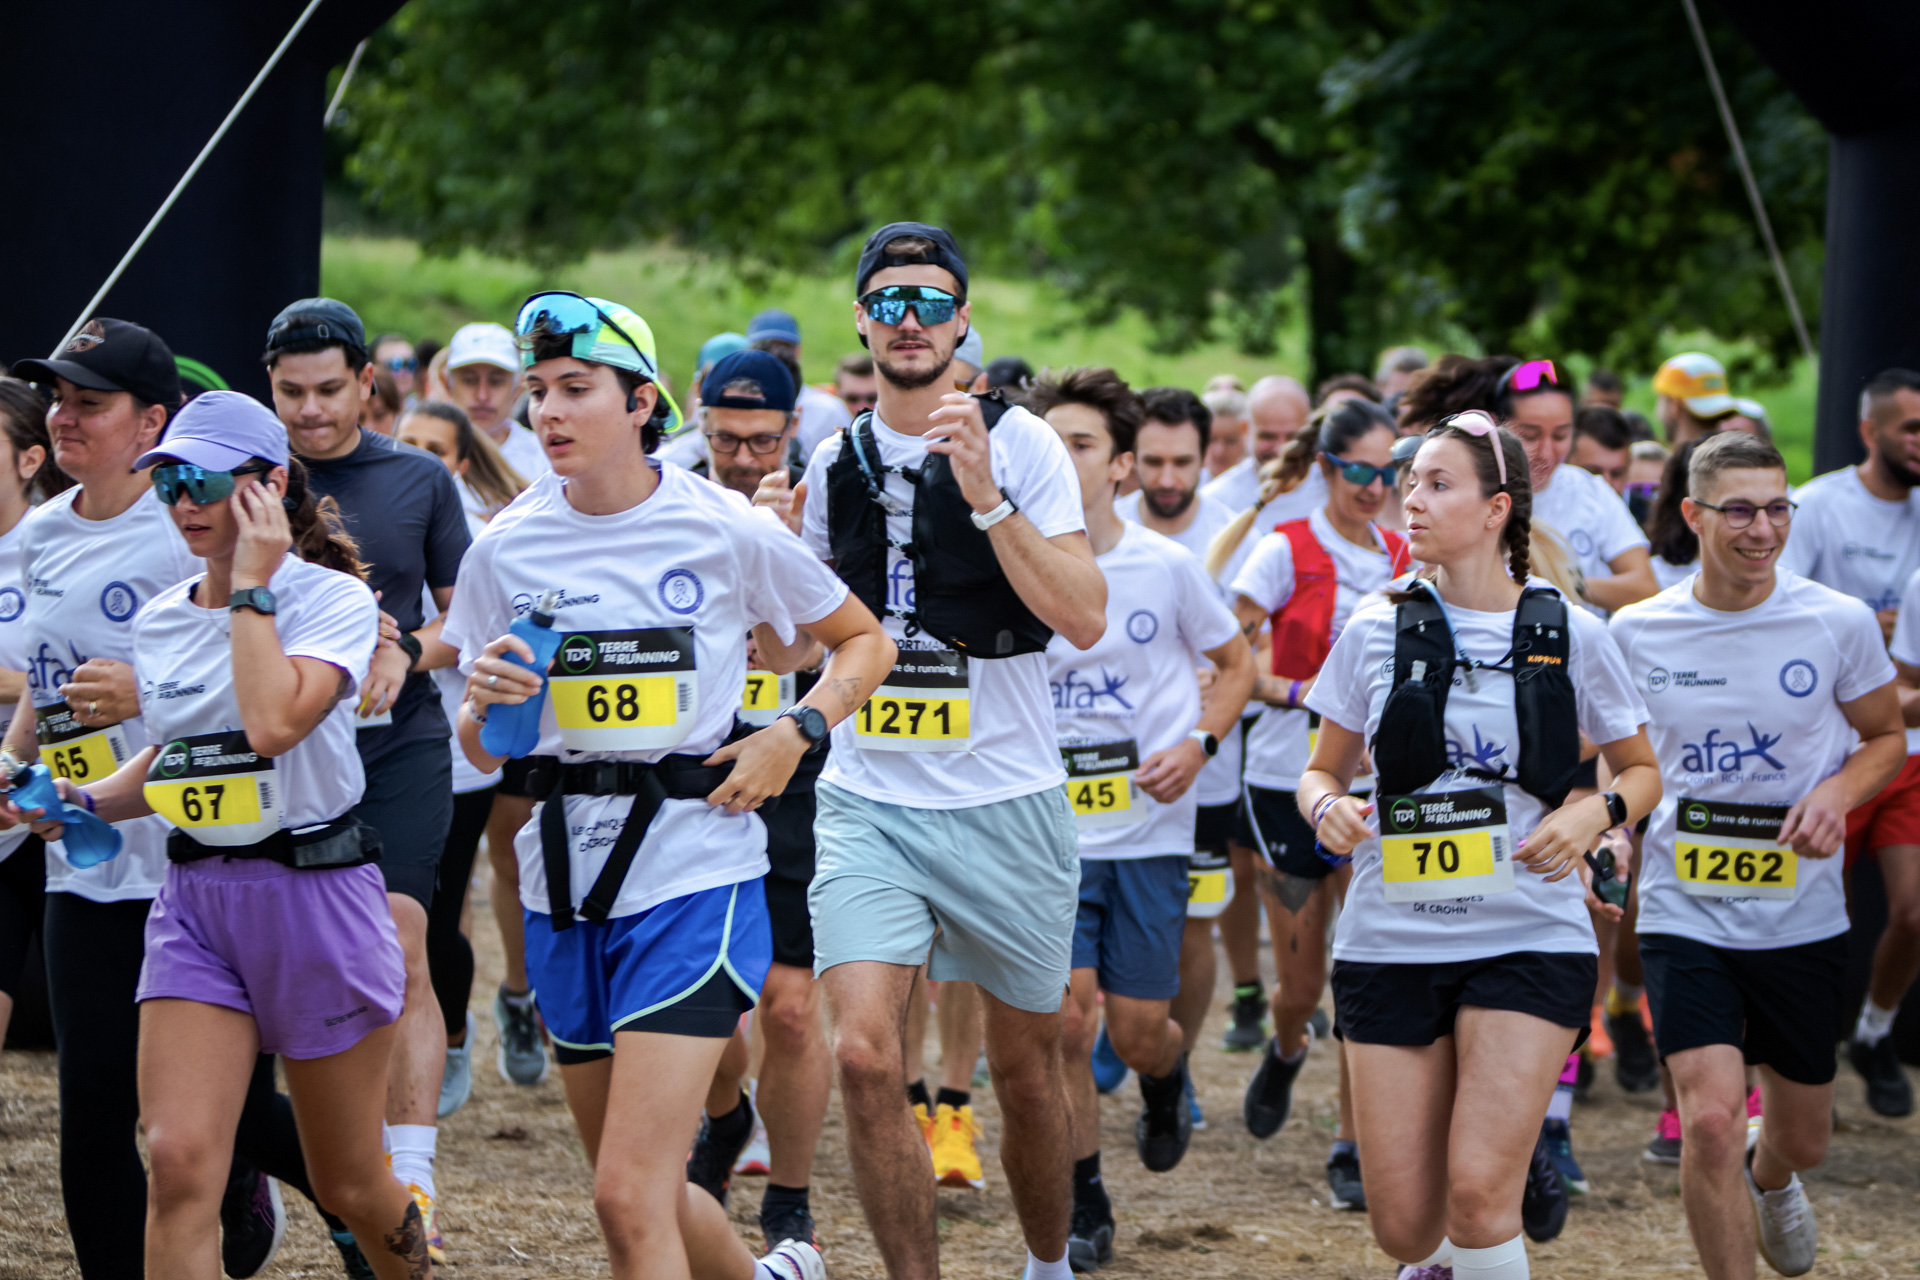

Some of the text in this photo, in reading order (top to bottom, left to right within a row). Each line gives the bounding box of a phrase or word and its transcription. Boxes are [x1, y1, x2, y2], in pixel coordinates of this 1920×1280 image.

[598, 640, 639, 654] TERRE
[564, 648, 593, 662] TDR
[616, 650, 681, 666] RUNNING
[1527, 655, 1562, 665] KIPRUN
[903, 663, 916, 673] de
[917, 664, 957, 676] running
[1672, 671, 1699, 680] TERRE
[1650, 674, 1667, 685] TDR
[1684, 678, 1728, 687] RUNNING
[587, 683, 640, 723] 68
[860, 699, 951, 736] 1271
[189, 744, 223, 758] TERRE
[1681, 728, 1742, 774] afa
[54, 746, 89, 780] 65
[203, 752, 258, 767] RUNNING
[1684, 770, 1787, 785] Crohn RCH France
[182, 784, 226, 822] 67
[1419, 801, 1455, 815] TERRE
[1392, 809, 1417, 823] TDR
[1435, 807, 1492, 825] RUNNING
[1712, 813, 1735, 823] terre
[1737, 814, 1750, 824] de
[1413, 840, 1460, 876] 70
[1684, 848, 1784, 883] 1262
[1413, 902, 1468, 915] DE CROHN
